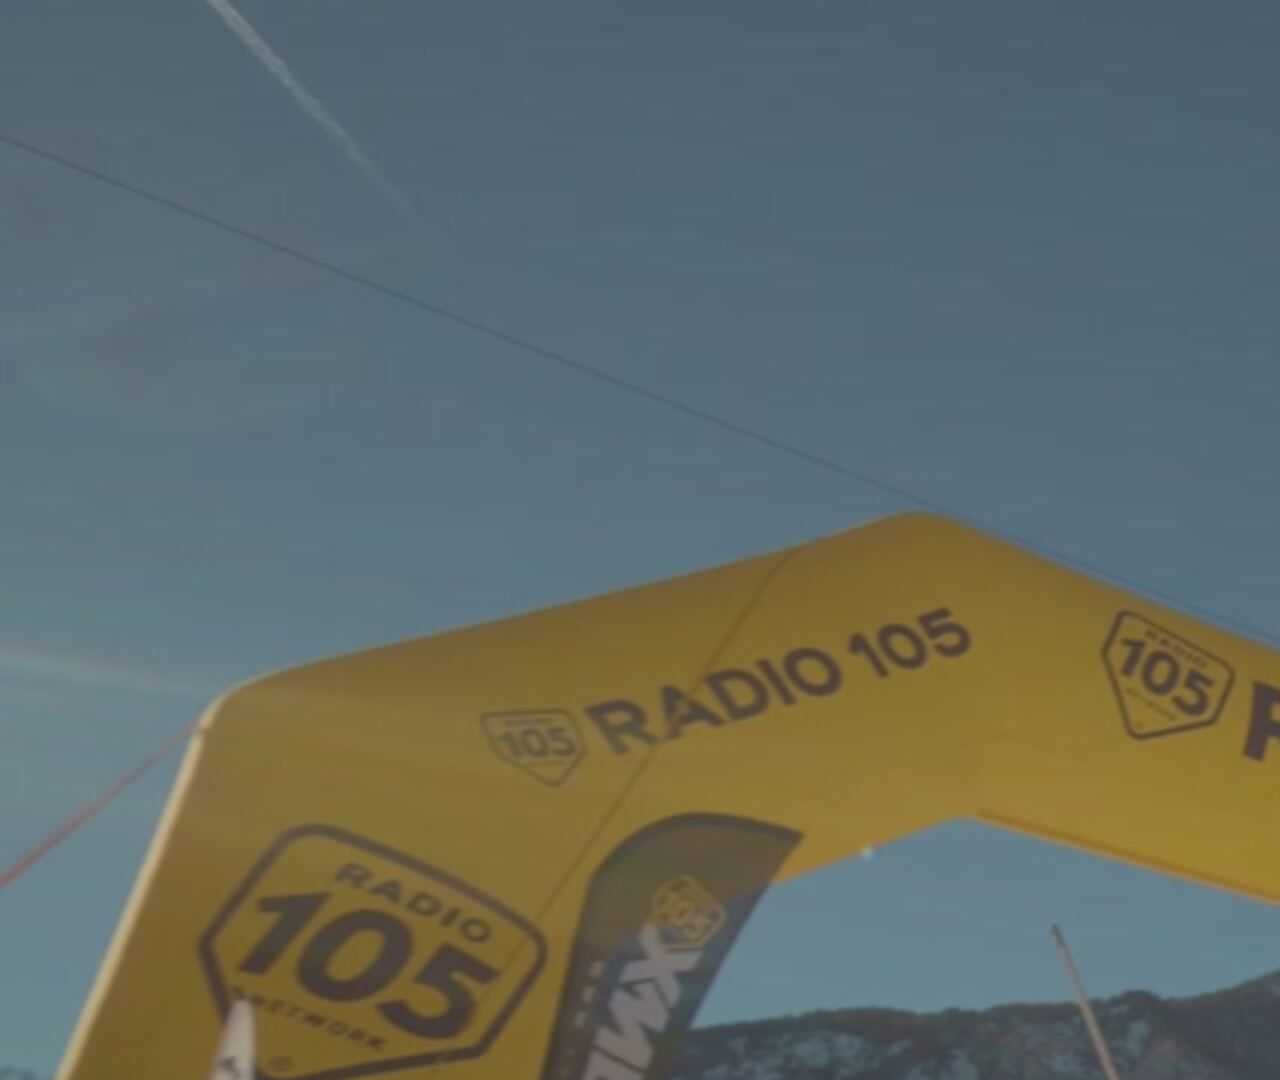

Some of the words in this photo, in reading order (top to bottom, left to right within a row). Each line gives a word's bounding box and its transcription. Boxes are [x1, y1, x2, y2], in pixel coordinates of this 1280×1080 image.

[584, 645, 845, 755] RADIO
[847, 605, 974, 679] 105
[1118, 637, 1217, 718] 105
[497, 725, 577, 760] 105
[335, 861, 493, 943] RADIO
[232, 890, 500, 1040] 105
